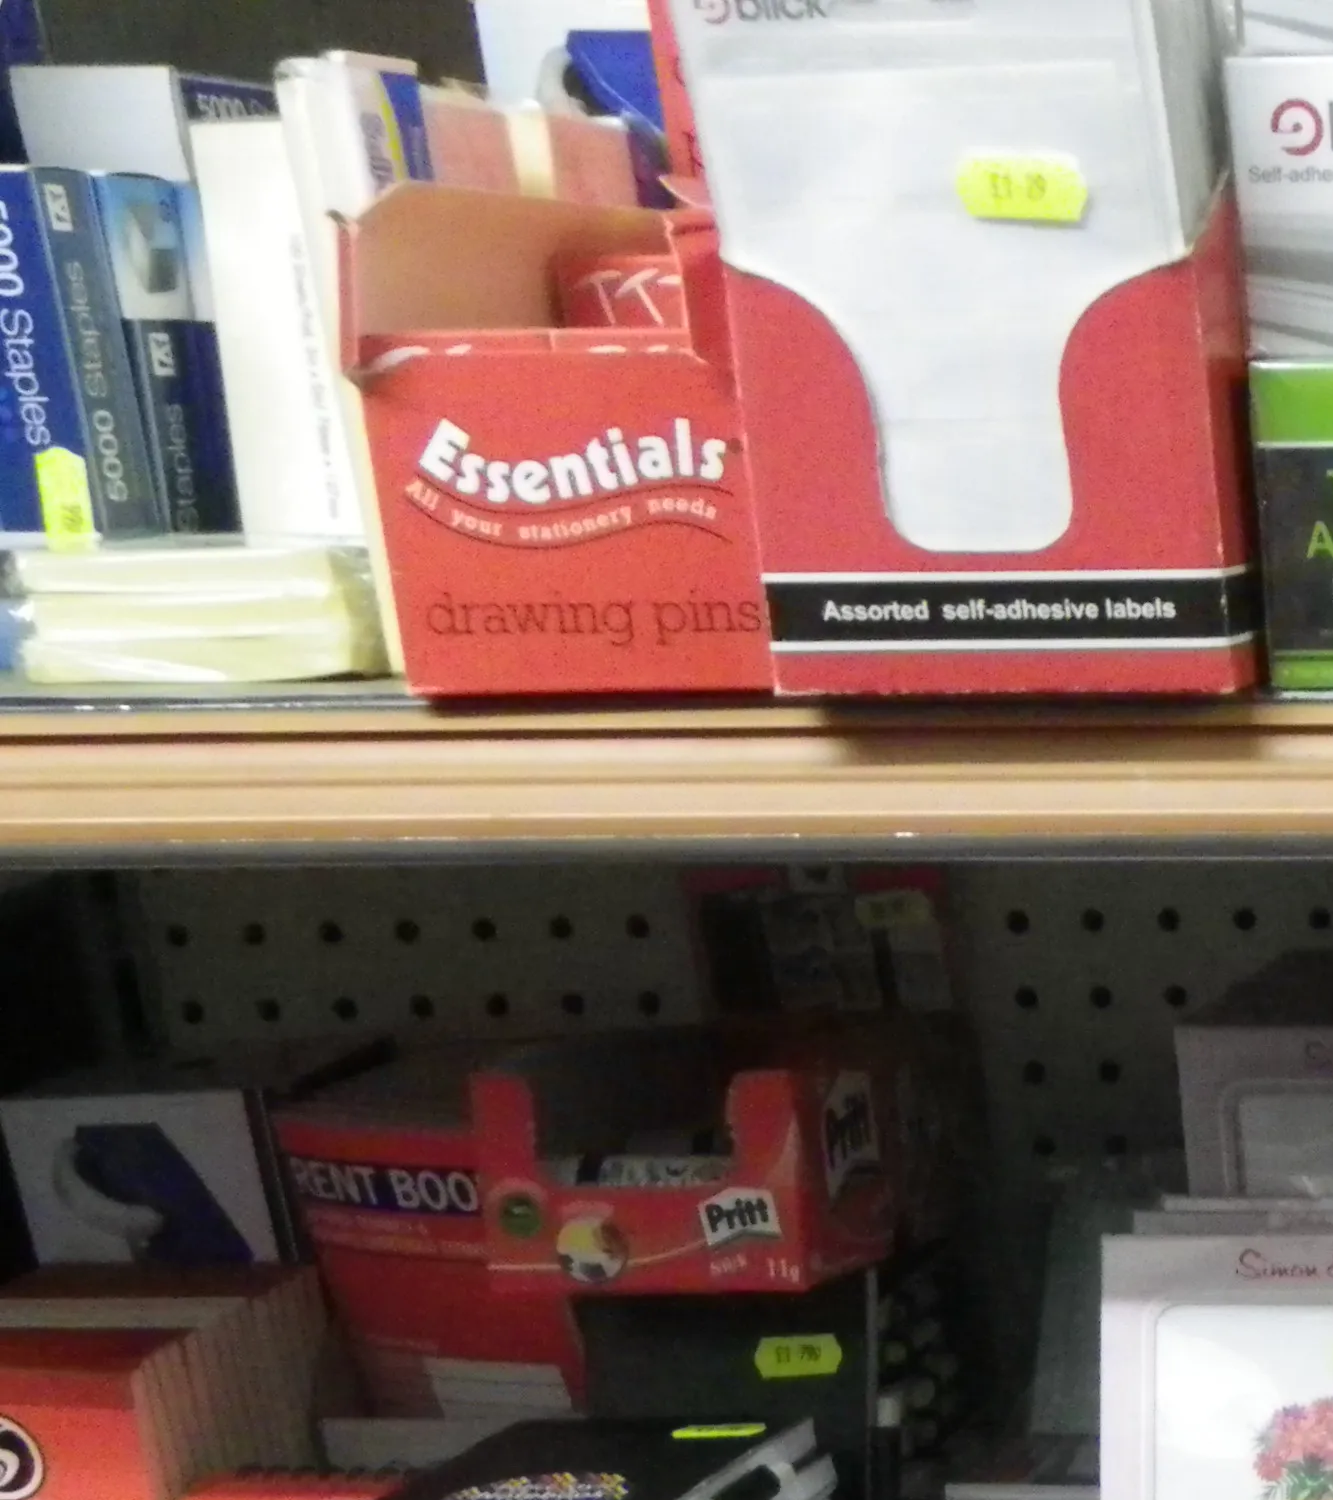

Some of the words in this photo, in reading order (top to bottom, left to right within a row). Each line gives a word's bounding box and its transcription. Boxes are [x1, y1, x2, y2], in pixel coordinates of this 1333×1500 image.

[1, 308, 51, 447] Staples
[419, 416, 727, 505] Essentials
[450, 507, 504, 539] your
[517, 504, 633, 542] stationery
[426, 592, 634, 646] drawing
[654, 590, 763, 646] pins
[822, 599, 930, 622] Assorted
[941, 597, 1100, 621] self-adhesive
[1104, 595, 1177, 620] labels
[387, 1168, 482, 1213] BOO
[704, 1197, 769, 1233] Pritt
